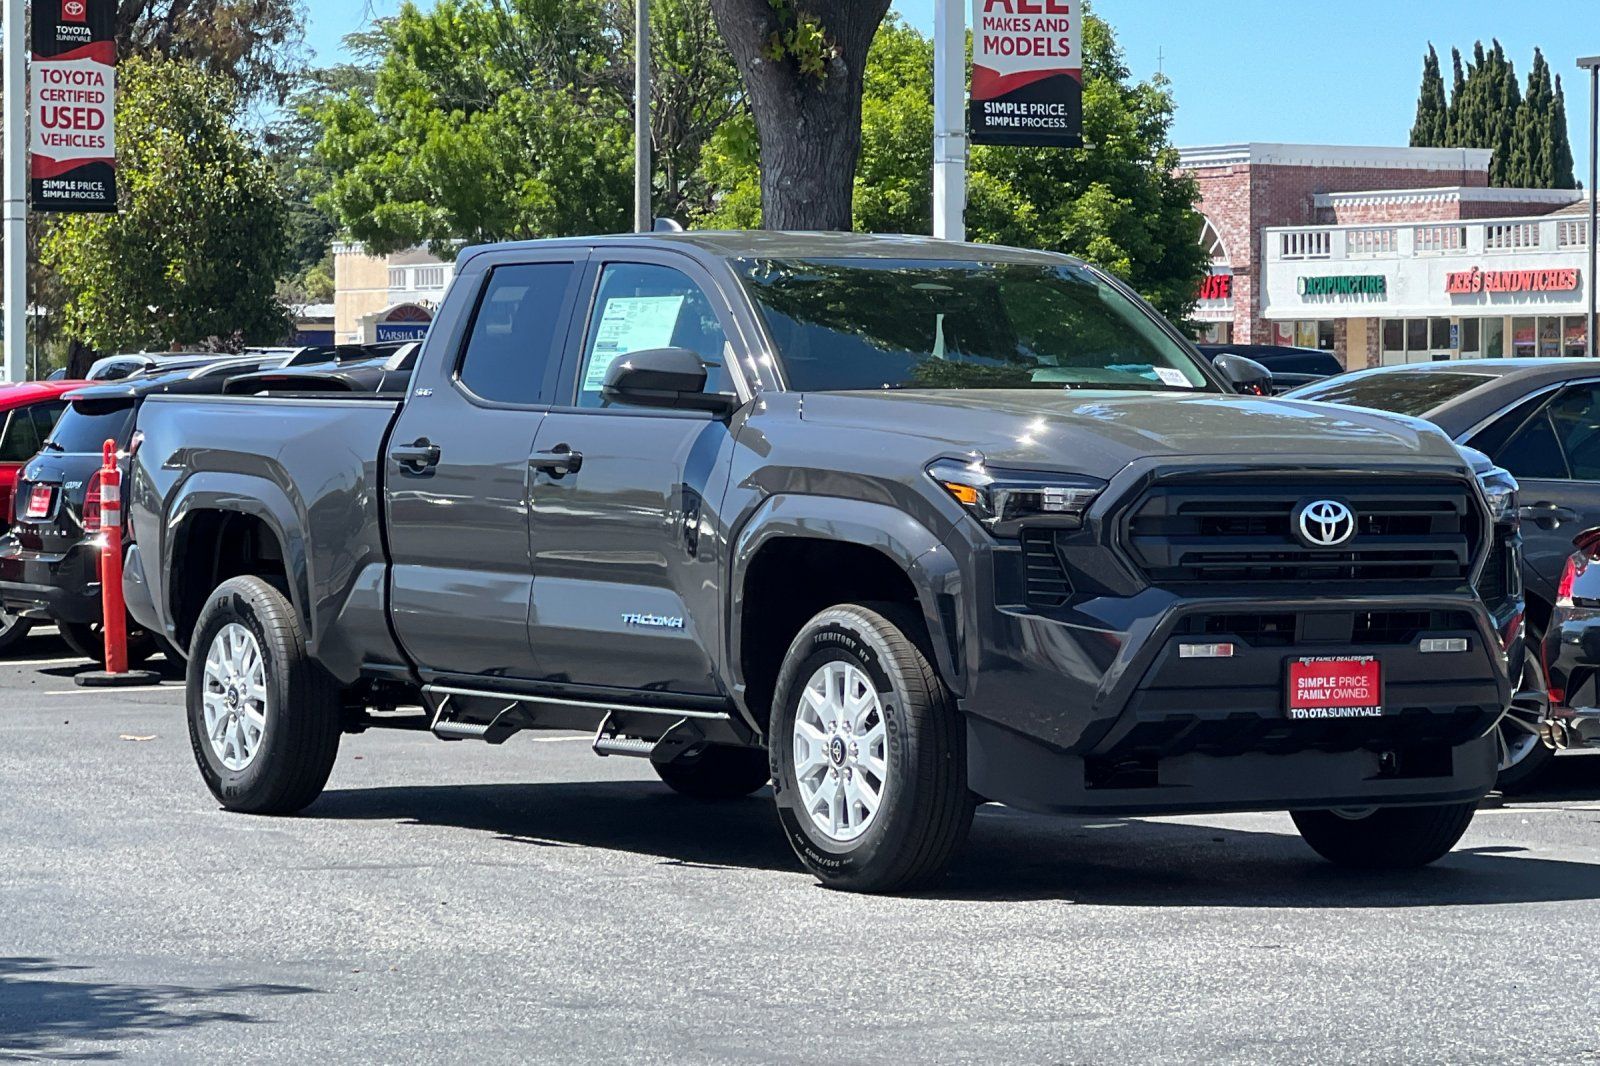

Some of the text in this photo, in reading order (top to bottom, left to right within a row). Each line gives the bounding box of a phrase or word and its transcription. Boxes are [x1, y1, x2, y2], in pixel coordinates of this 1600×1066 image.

[56, 25, 92, 35] TOYOTA
[983, 17, 1069, 32] MAKES AND
[56, 34, 92, 42] SUNNYVALE
[983, 35, 1070, 57] MODELS
[40, 69, 105, 86] TOYOTA
[40, 89, 105, 104] CERTIFIED
[984, 102, 1068, 116] SIMPLE PRICE.
[40, 106, 105, 131] USED
[985, 116, 1068, 128] SIMPLE PROCESS.
[41, 133, 105, 148] VEHICLES
[42, 180, 105, 191] SIMPLE PRICE.
[42, 190, 106, 199] SIMPLE PROCESS.
[1200, 274, 1230, 299] USE
[1305, 275, 1385, 295] ACUPUNCTURE
[1445, 266, 1578, 293] LEE'S SANDWICHES
[378, 329, 413, 341] VARSHA
[621, 613, 683, 628] TACOMA
[814, 632, 857, 649] TERRITORY
[1298, 676, 1370, 688] SIMPLE PRICE.
[1297, 688, 1370, 700] FAMILY OWNED.
[1291, 706, 1381, 719] TOYOTA SUNNYVALE
